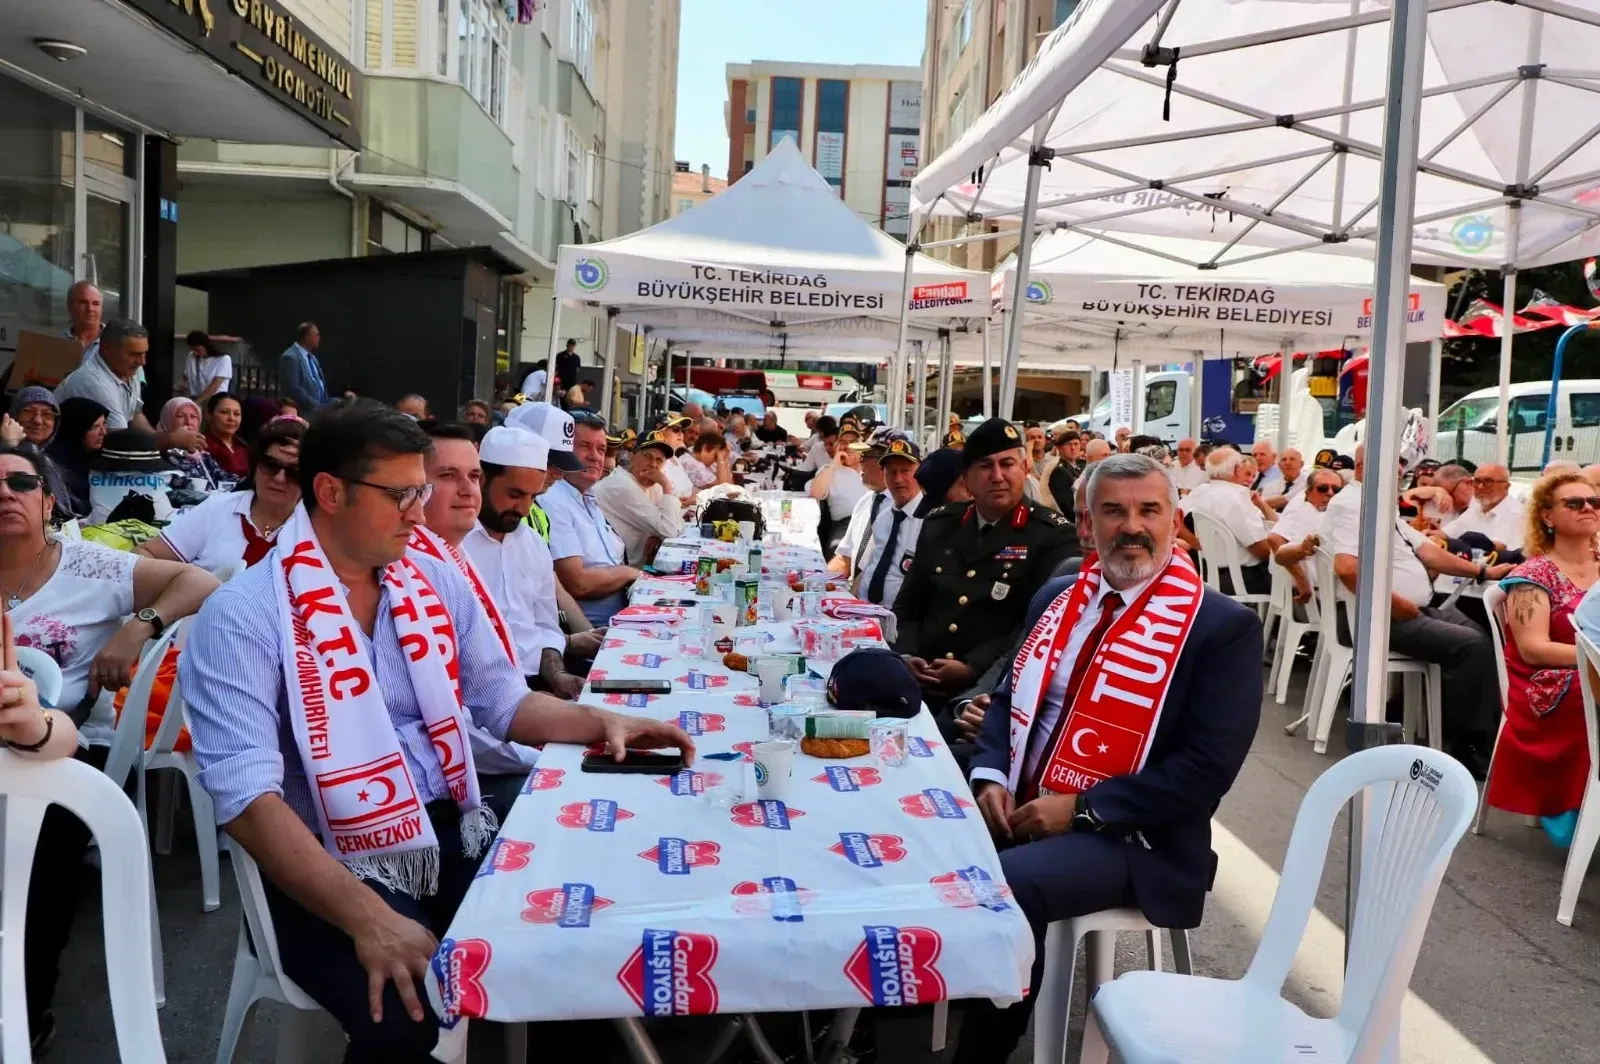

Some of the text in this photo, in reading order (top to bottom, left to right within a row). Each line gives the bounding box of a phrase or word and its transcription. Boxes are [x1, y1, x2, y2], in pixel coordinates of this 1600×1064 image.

[232, 0, 353, 99] GAYRİMENKUL
[265, 55, 334, 121] OTOMOTİV
[637, 280, 884, 309] BÜYÜKŞEHİR BELEDİYESİ
[728, 268, 828, 289] TEKİRDAĞ
[1174, 282, 1276, 304] TEKİRDAĞ
[1216, 307, 1333, 326] BELEDİYESİ
[295, 650, 332, 760] CUMHURİYETİ
[335, 816, 423, 855] ÇERKEZKÖY
[674, 936, 695, 1016] Candan
